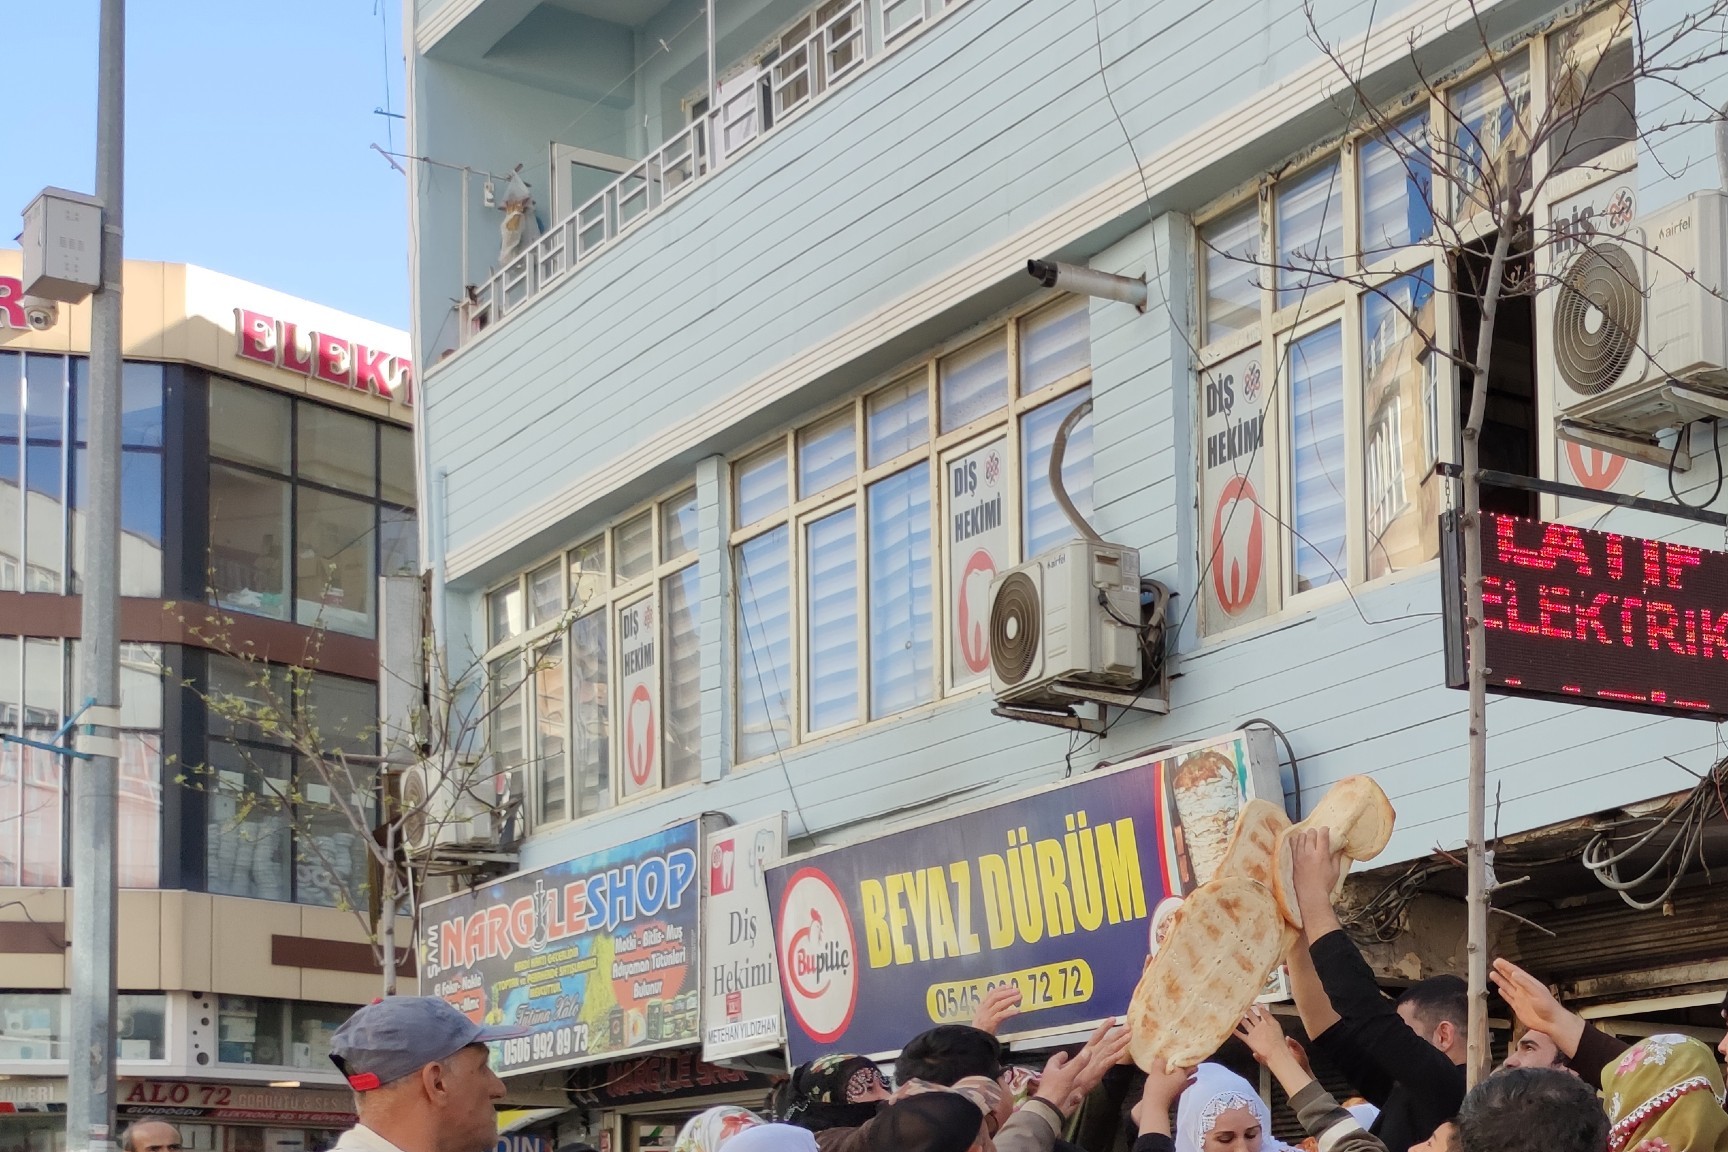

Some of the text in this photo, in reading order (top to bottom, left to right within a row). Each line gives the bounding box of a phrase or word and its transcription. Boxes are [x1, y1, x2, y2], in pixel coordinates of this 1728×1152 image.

[1665, 217, 1691, 239] airfel
[860, 809, 1148, 970] BEYAZ DÜRÜM
[729, 907, 757, 947] Diş
[713, 954, 773, 997] Hekimi
[797, 940, 850, 984] Bupiliç
[934, 984, 980, 1018] 0545
[1027, 972, 1053, 1004] 72
[1058, 965, 1084, 999] 72
[504, 1023, 589, 1066] 0506 992 89 73
[708, 1016, 777, 1045] METEHAN YILDIZHAN
[126, 1081, 190, 1104] ALO
[200, 1085, 232, 1106] 72
